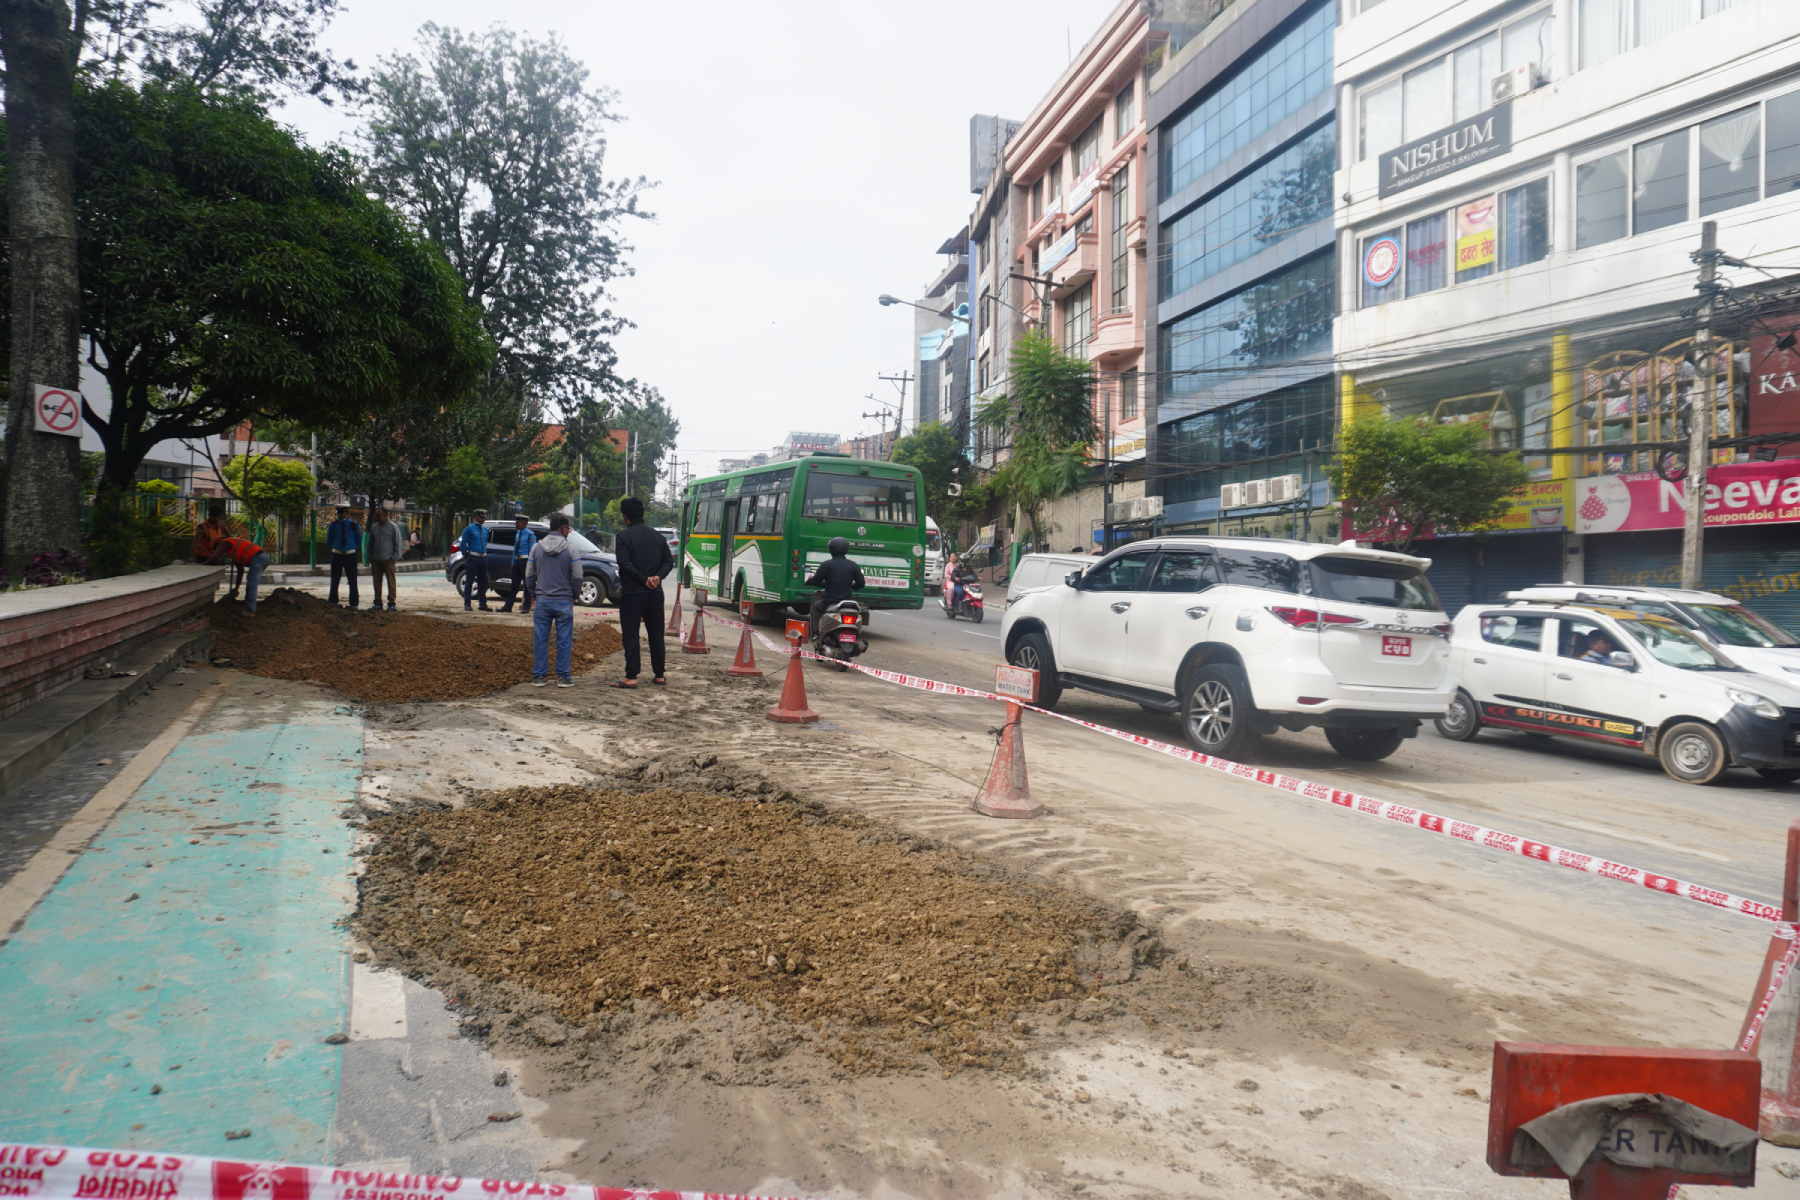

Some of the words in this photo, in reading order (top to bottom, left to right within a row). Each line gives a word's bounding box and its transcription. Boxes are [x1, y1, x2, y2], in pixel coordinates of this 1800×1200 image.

[1391, 116, 1495, 178] NISHUM
[1397, 170, 1426, 188] MAKEUP
[1425, 161, 1451, 177] STUDIO
[1457, 147, 1489, 165] SALOON
[799, 442, 827, 451] ALICE
[1659, 476, 1800, 513] Neeva
[998, 682, 1016, 693] WATER
[1016, 686, 1031, 696] TANK
[1515, 708, 1602, 729] SUZUKI
[1231, 767, 1255, 778] CAUTION
[1303, 788, 1329, 800] CAUTION
[1306, 782, 1331, 793] STOP
[1358, 806, 1379, 815] ENTER
[1368, 803, 1380, 811] NOT
[1389, 804, 1418, 816] STOP
[1386, 811, 1415, 825] CAUTION
[1451, 821, 1481, 833] DANGER
[1461, 829, 1475, 837] NOT
[1450, 832, 1475, 842] ENTER
[1486, 831, 1519, 844] STOP
[1483, 838, 1517, 852] CAUTION
[1558, 855, 1569, 863] DO
[1571, 859, 1588, 868] NOT
[1559, 849, 1594, 863] DANGER
[1601, 861, 1640, 877] STOP
[1598, 869, 1638, 885] CAUTION
[1688, 884, 1730, 902] DANGER
[1649, 1129, 1731, 1157] TAN
[331, 1169, 463, 1193] CAUTION
